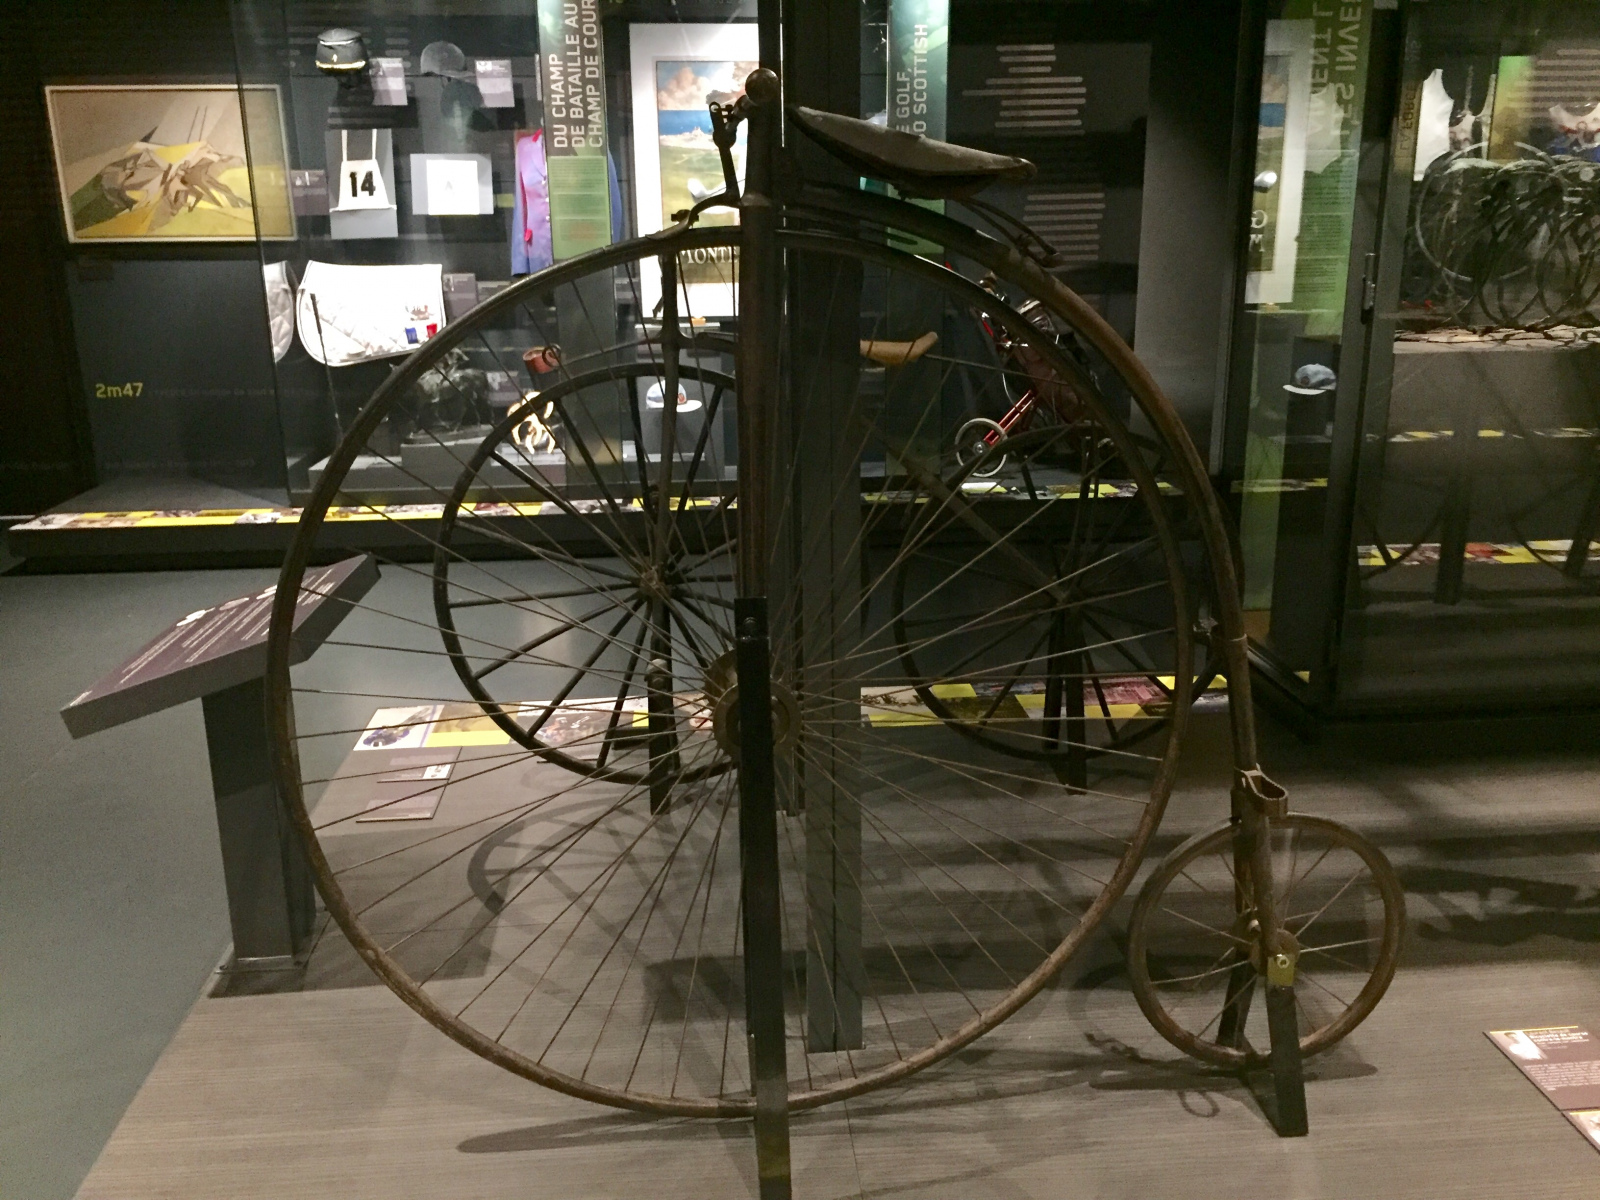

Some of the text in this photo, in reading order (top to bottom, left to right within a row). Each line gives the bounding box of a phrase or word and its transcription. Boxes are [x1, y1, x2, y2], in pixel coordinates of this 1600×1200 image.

[563, 3, 586, 148] DE BATAILLE AU
[585, 55, 599, 78] DE
[896, 68, 912, 119] GOLF,
[913, 24, 928, 114] SCOTTISH
[548, 53, 568, 148] DU CHAMP
[586, 84, 603, 148] CHAMP
[349, 170, 376, 198] 14
[95, 382, 143, 398] 2m47
